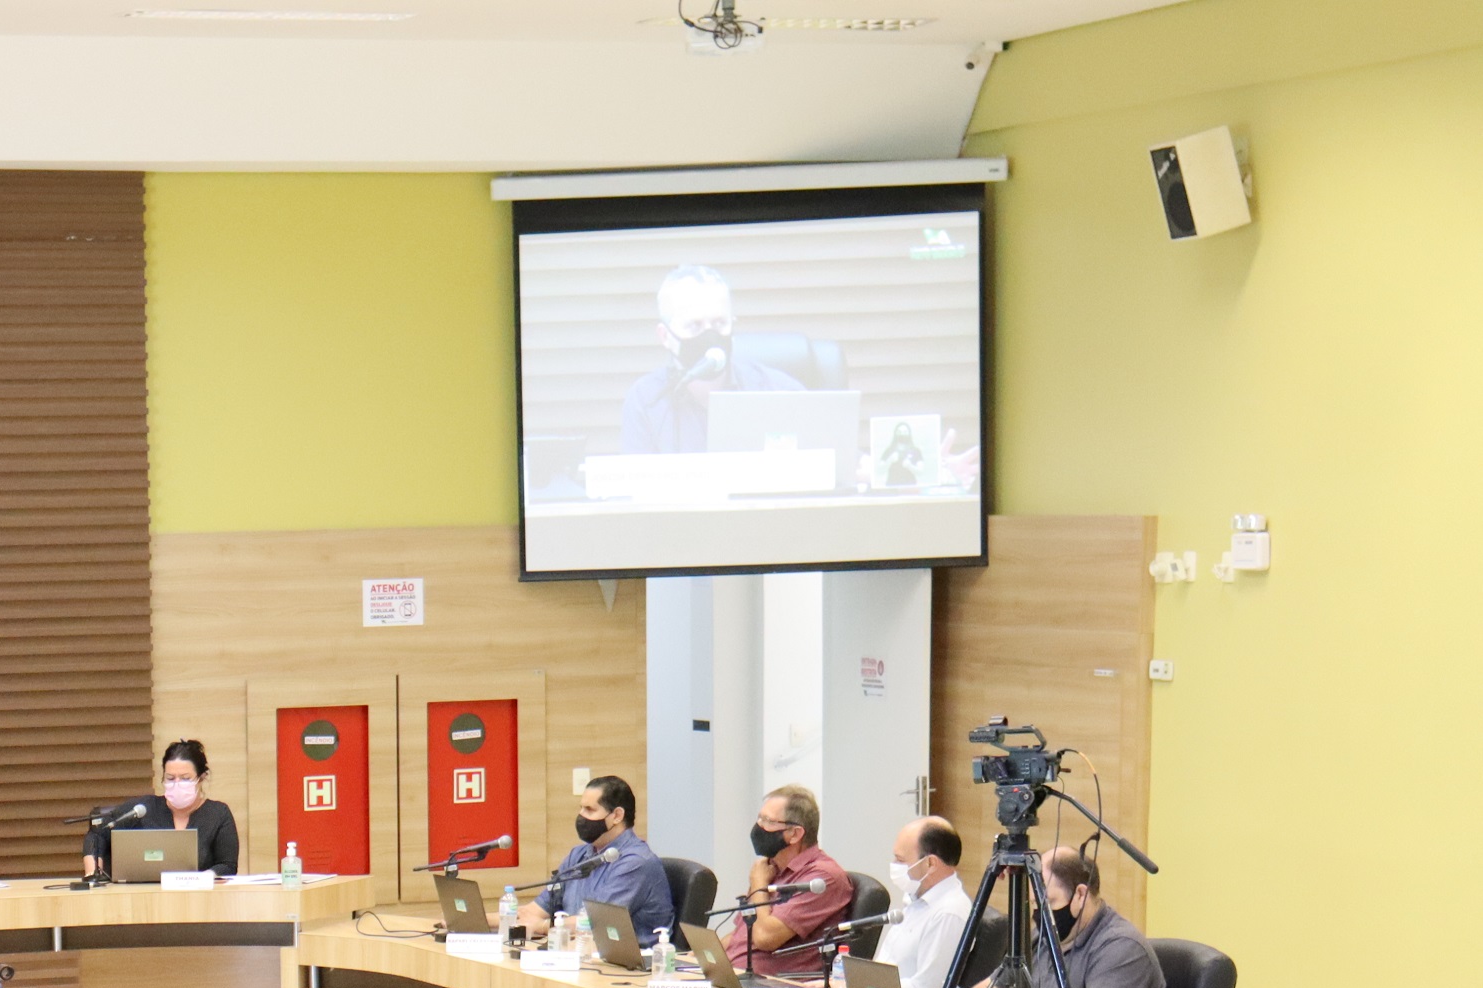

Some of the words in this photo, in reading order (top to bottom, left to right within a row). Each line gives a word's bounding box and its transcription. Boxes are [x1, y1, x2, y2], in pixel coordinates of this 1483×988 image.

[370, 581, 415, 594] ATENÇÃO
[305, 736, 333, 744] INCÊNDIO
[452, 730, 481, 739] INCÊNDIO
[458, 773, 480, 798] H
[309, 781, 331, 805] H
